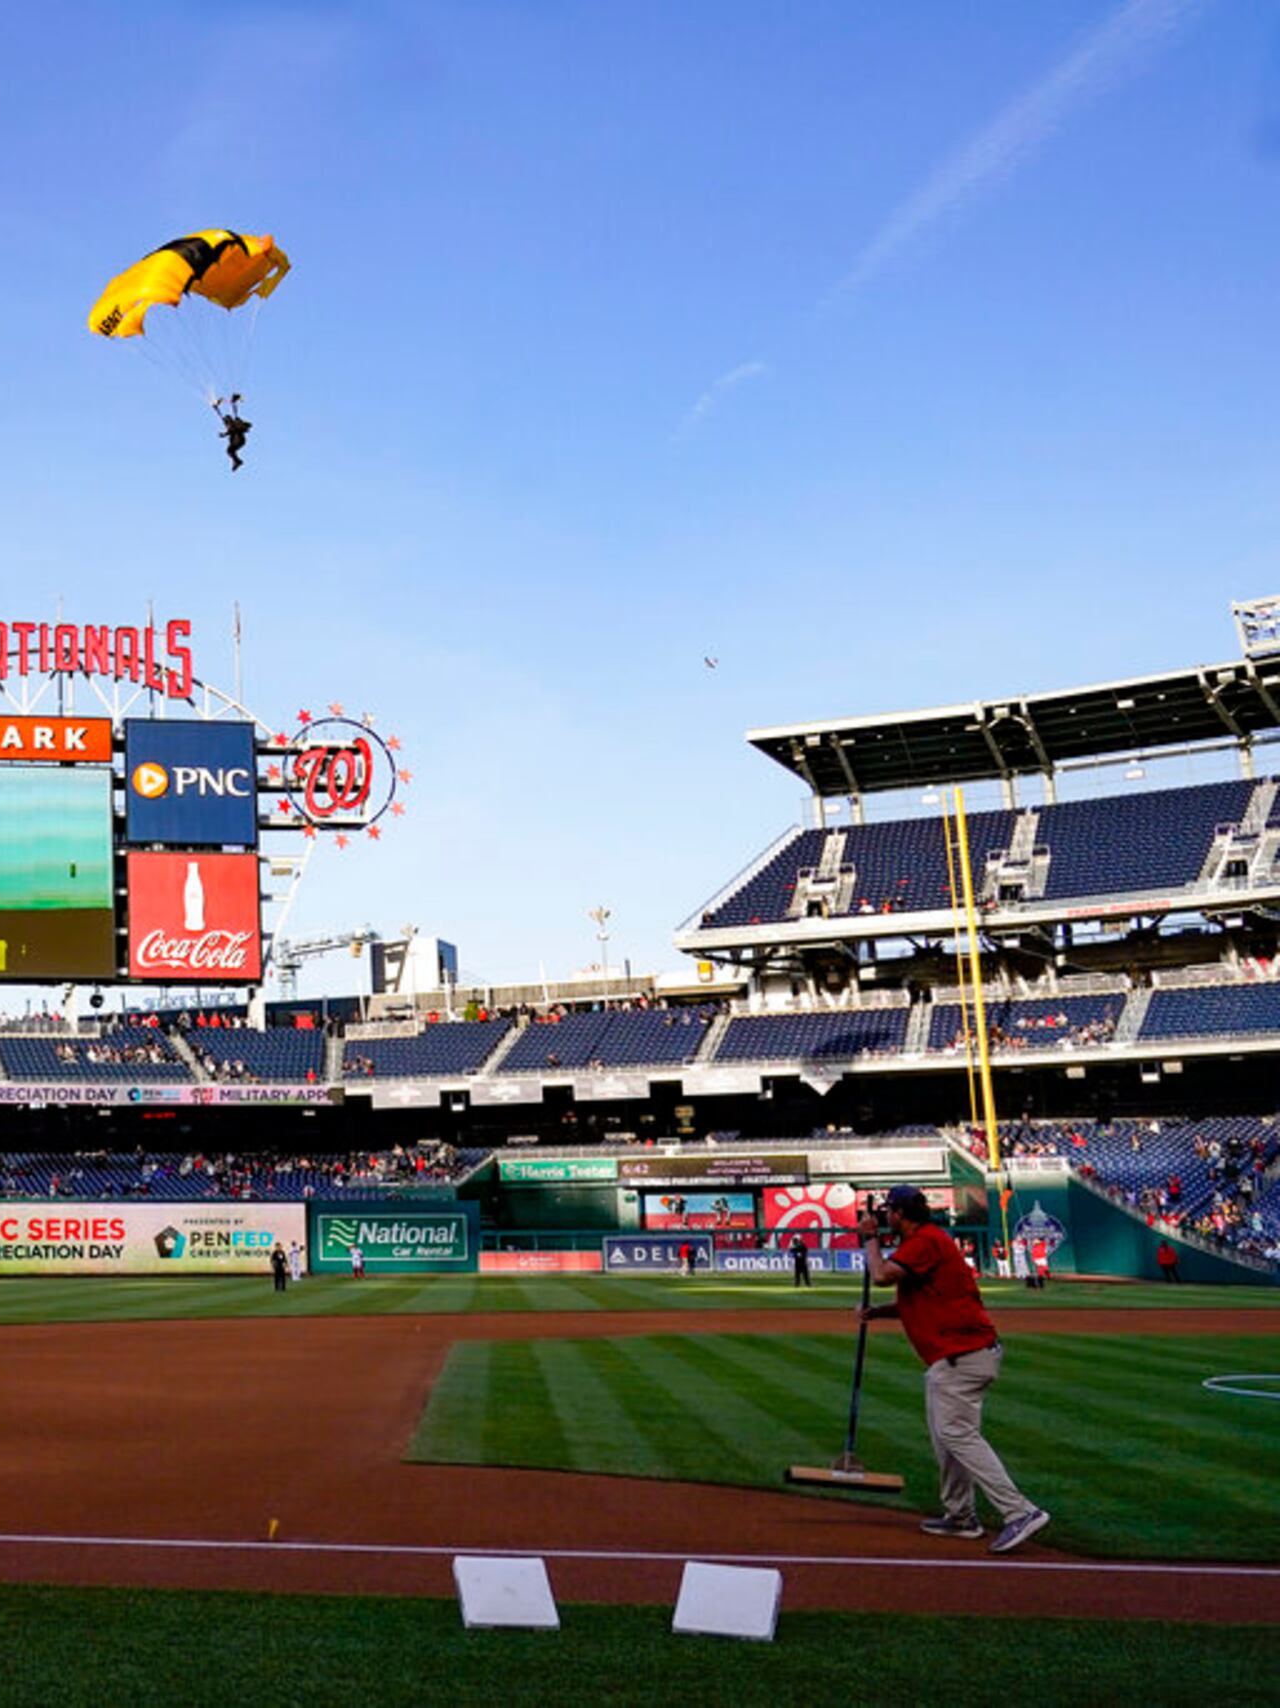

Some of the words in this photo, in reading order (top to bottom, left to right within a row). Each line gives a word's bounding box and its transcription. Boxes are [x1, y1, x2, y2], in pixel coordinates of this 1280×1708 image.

[172, 767, 252, 797] PNC
[137, 929, 254, 969] Coca-Cola
[86, 1088, 117, 1101] DAY
[220, 1087, 291, 1101] MILITARY
[521, 1166, 565, 1178] Harris
[27, 1218, 126, 1241] SERIES
[358, 1222, 458, 1244] National
[190, 1231, 275, 1247] PENFED
[89, 1244, 123, 1259] DAY
[189, 1249, 230, 1258] CREDIT
[634, 1246, 709, 1262] DELA
[724, 1254, 824, 1270] amentm
